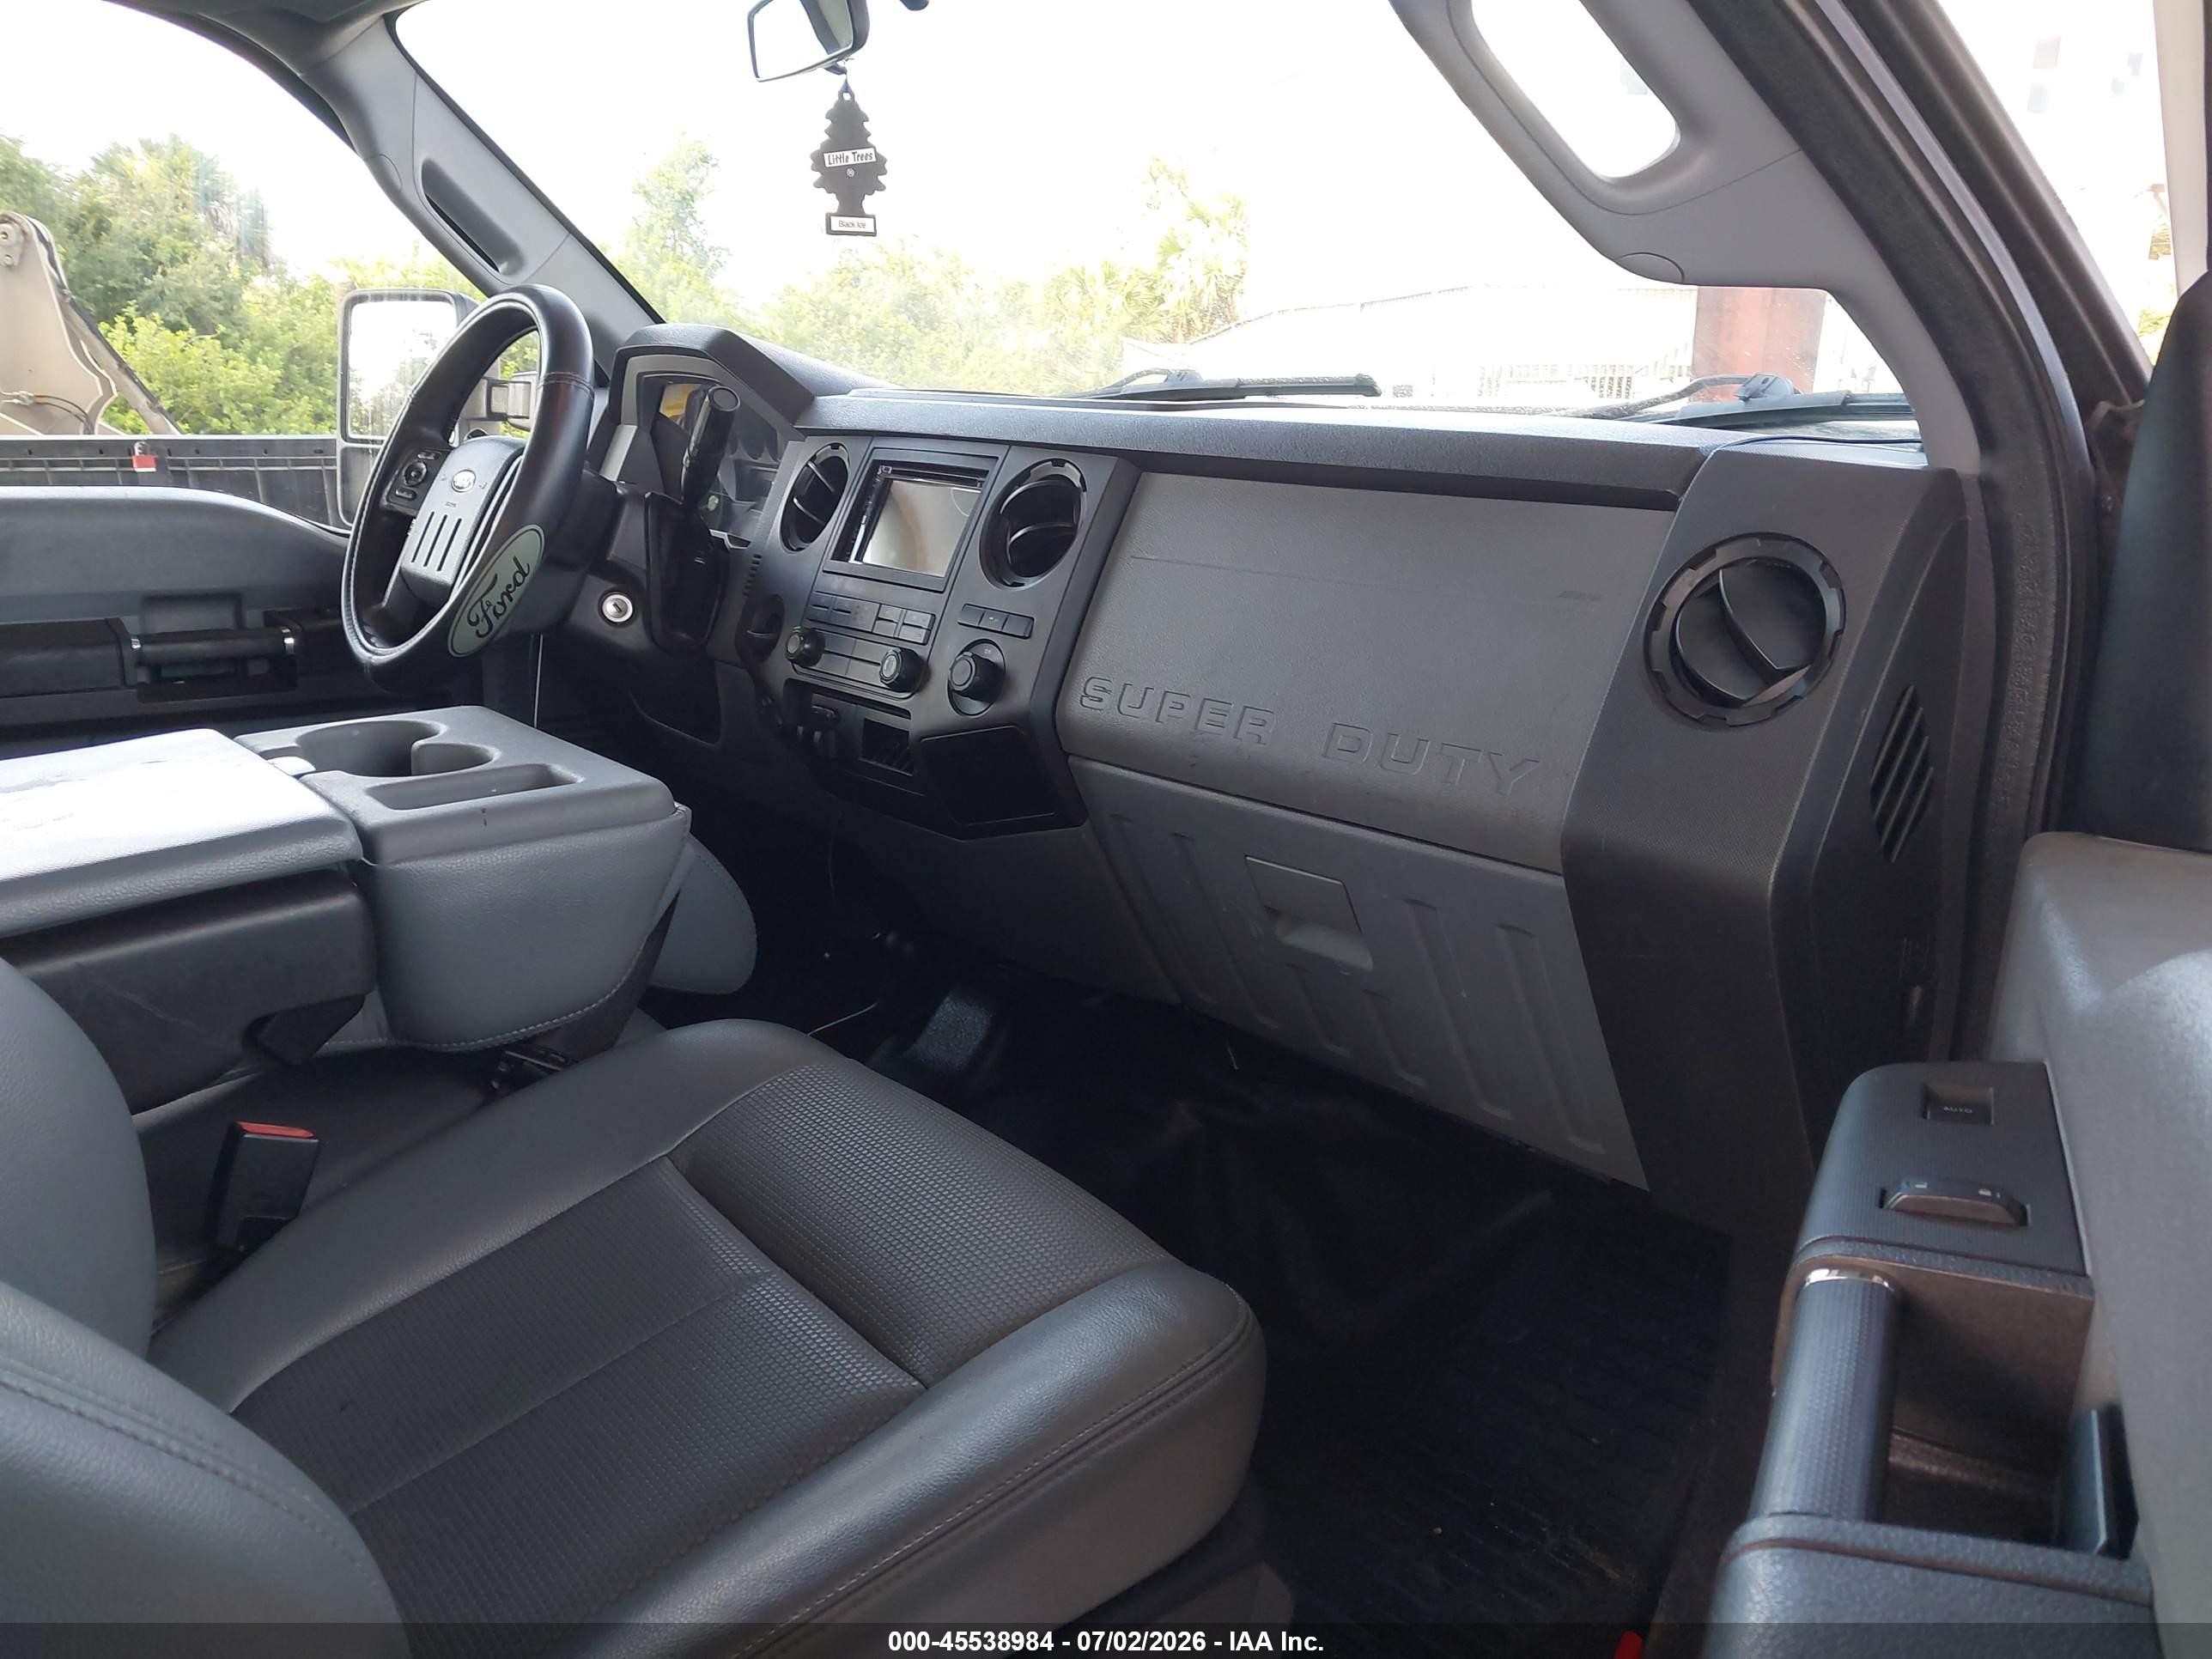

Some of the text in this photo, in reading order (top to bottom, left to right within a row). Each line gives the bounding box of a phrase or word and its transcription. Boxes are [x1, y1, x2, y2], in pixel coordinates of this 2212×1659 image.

[828, 151, 873, 166] Little Trees
[838, 220, 856, 228] Black
[467, 556, 531, 638] Ford
[1079, 675, 1540, 797] SUPER DUTY
